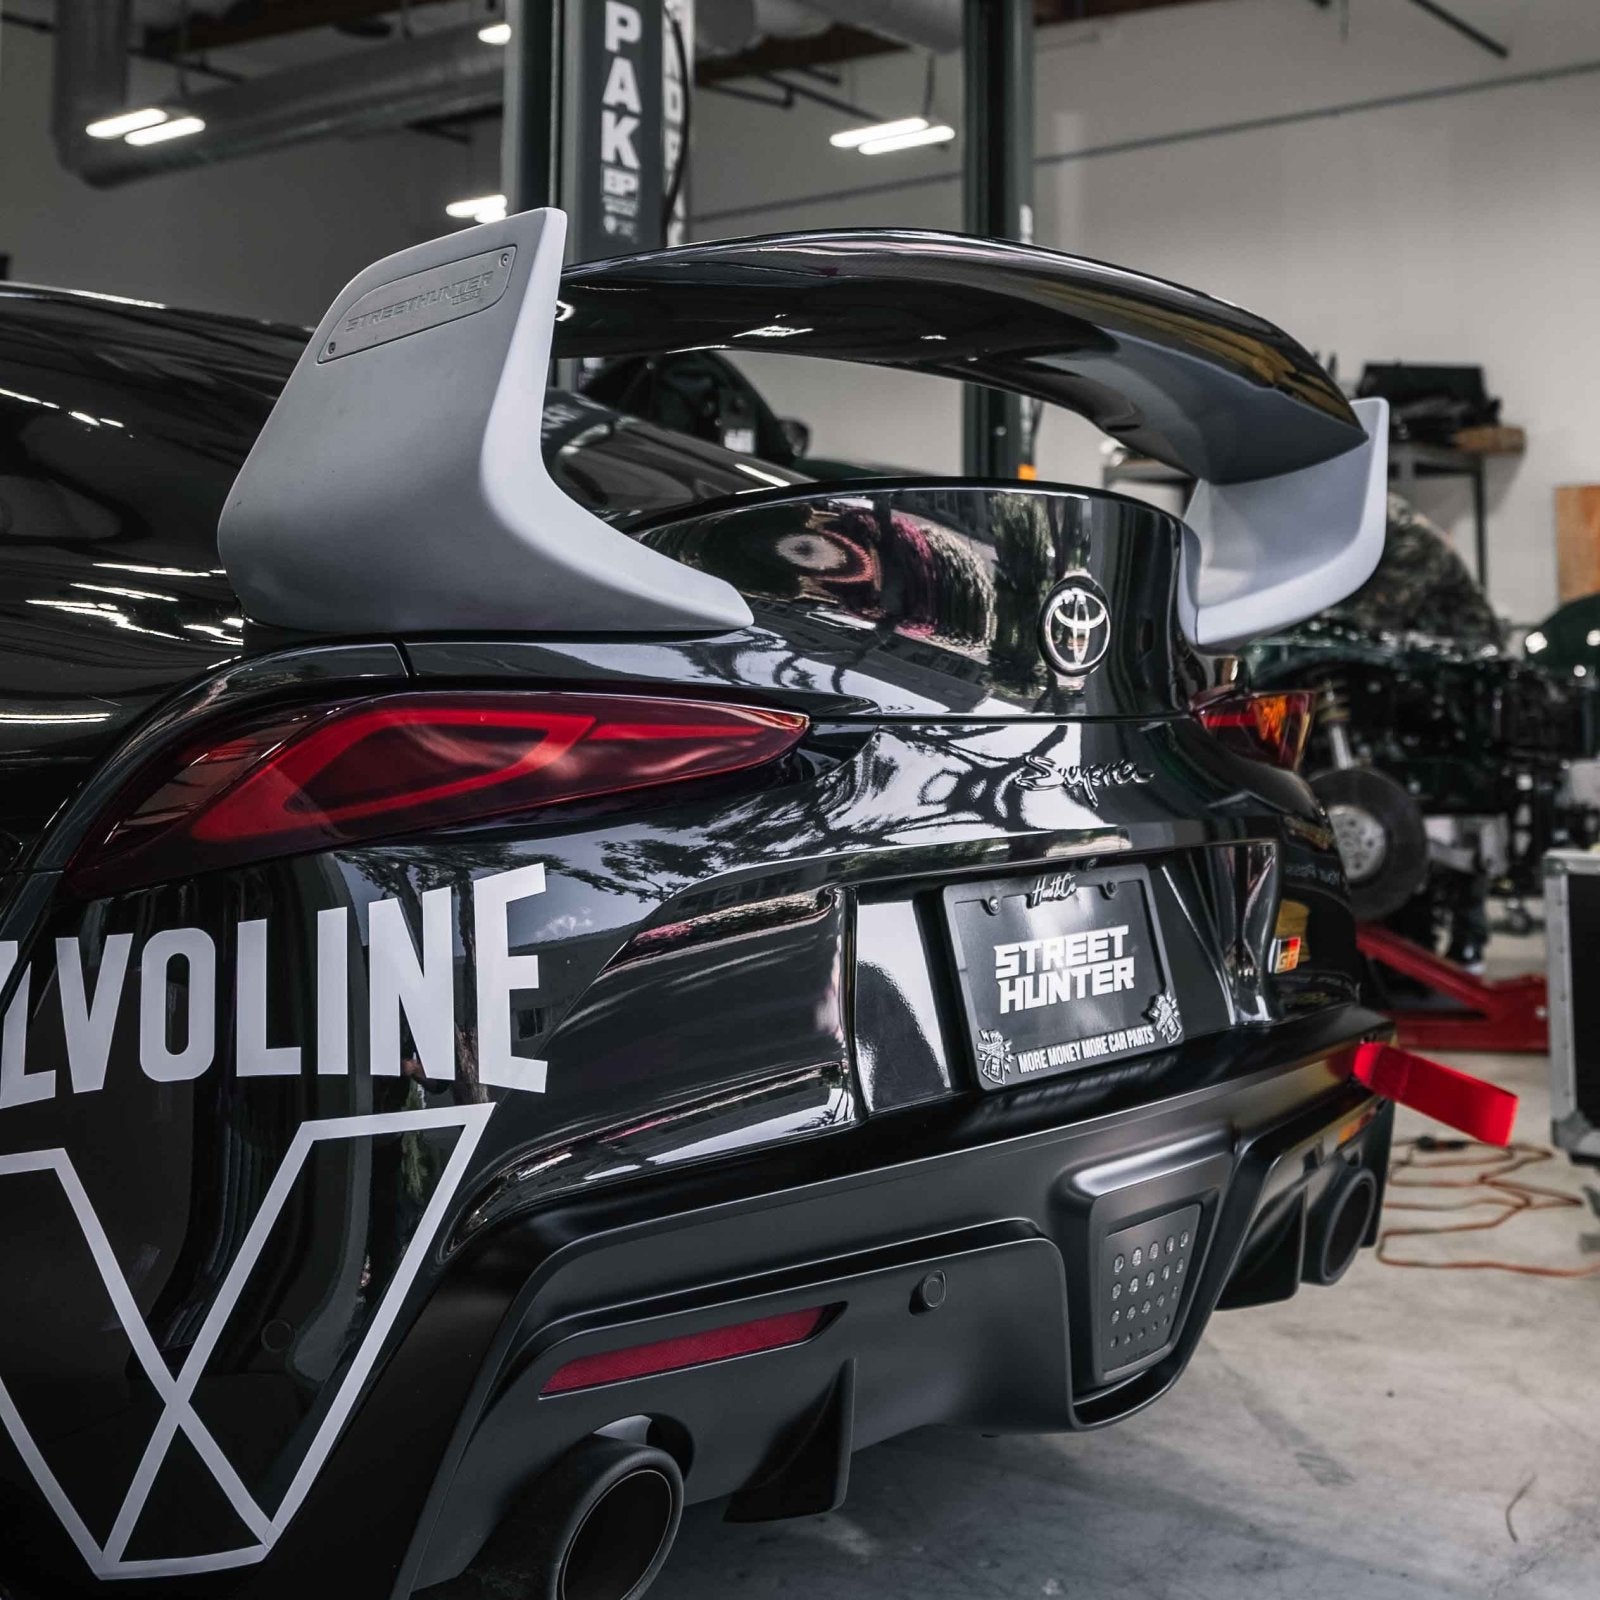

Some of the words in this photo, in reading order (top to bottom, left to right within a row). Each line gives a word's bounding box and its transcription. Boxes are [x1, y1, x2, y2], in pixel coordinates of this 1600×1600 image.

[602, 1, 641, 169] PAK
[1015, 754, 1155, 808] Supra
[993, 925, 1129, 979] STREET
[997, 956, 1135, 1014] HUNTER
[1017, 1049, 1049, 1073] MORE
[1047, 1042, 1081, 1067] MONEY
[1081, 1036, 1108, 1058] MORE
[1108, 1031, 1127, 1052] CAR
[1126, 1025, 1155, 1048] PARTS
